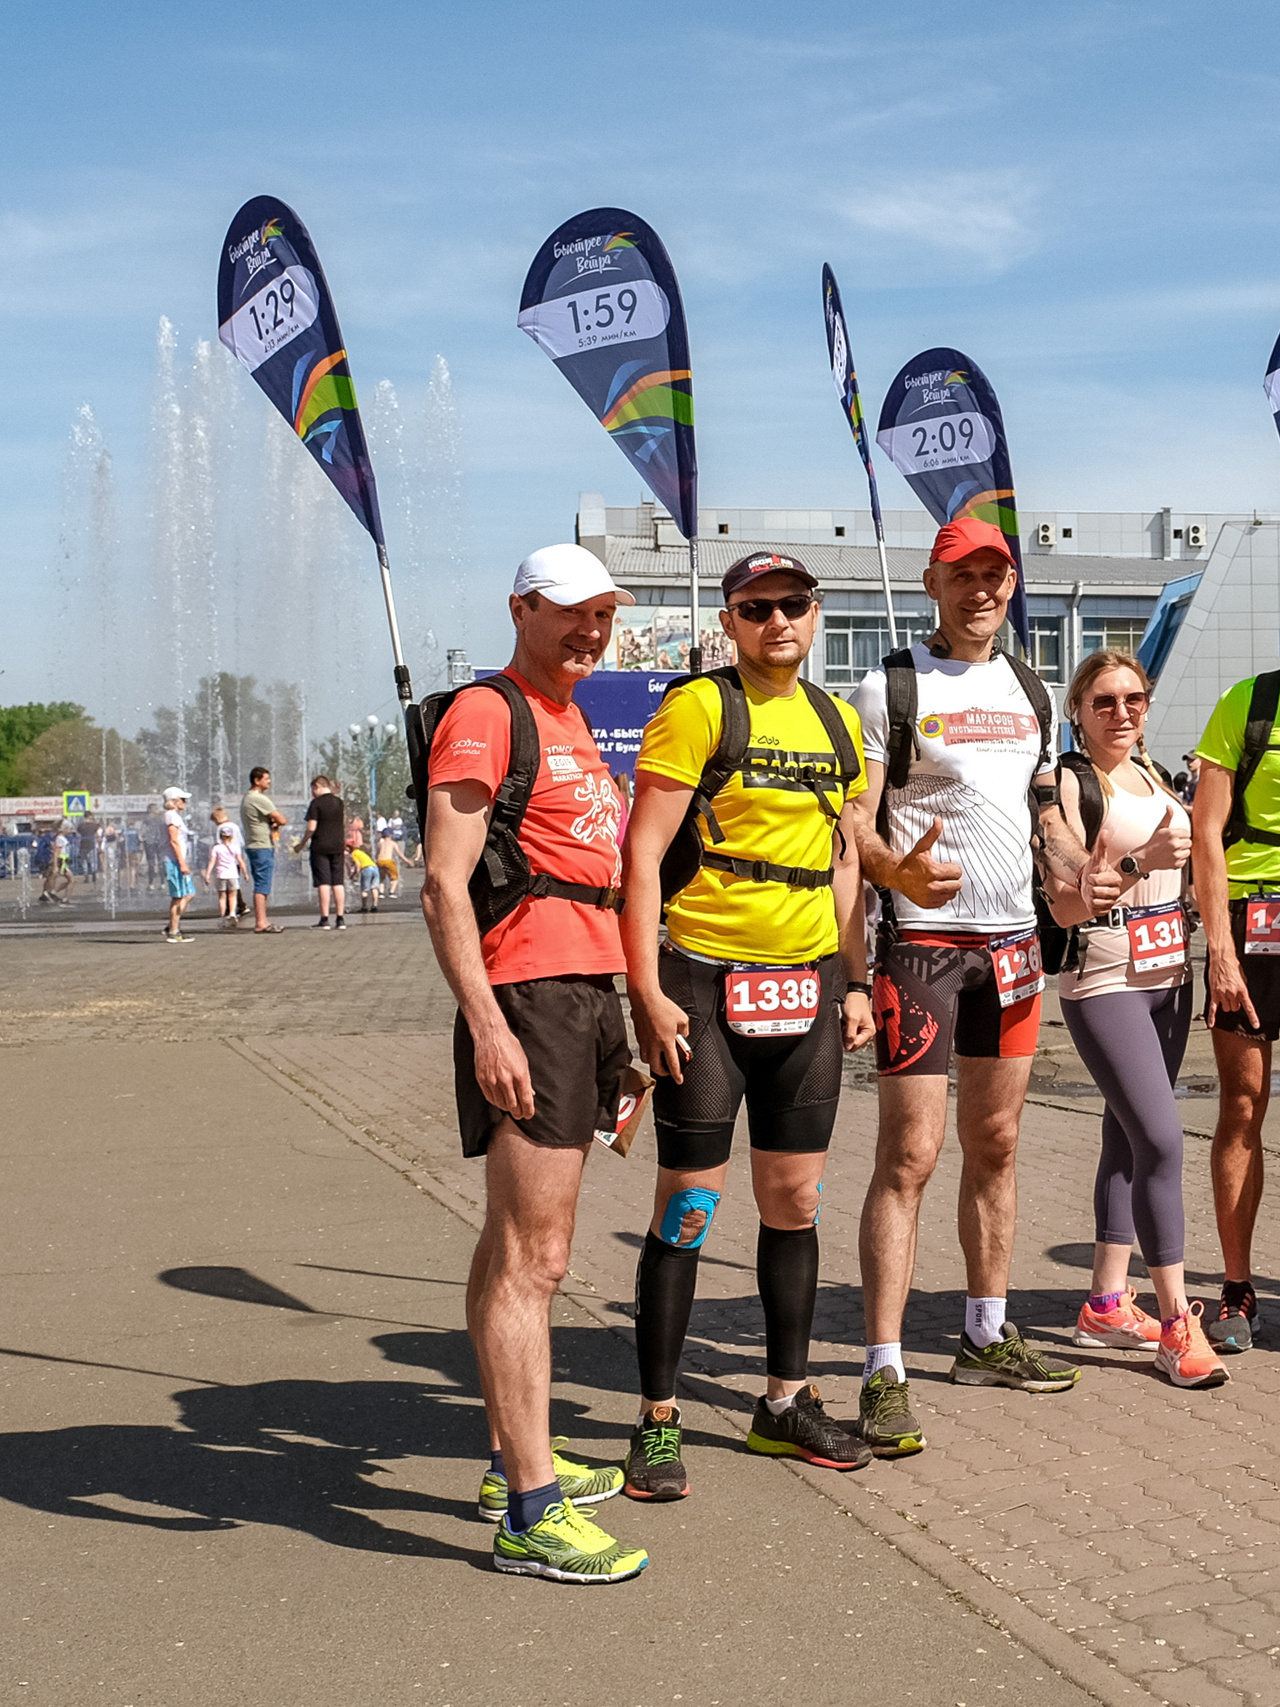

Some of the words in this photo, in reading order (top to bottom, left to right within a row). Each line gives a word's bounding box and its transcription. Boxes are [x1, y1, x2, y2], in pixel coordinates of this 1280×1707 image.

[228, 229, 260, 263] Быстрее
[553, 236, 602, 259] Быстрее
[245, 247, 271, 274] Ветра
[576, 254, 611, 274] Ветра
[249, 278, 295, 341] 1:29
[567, 288, 638, 334] 1:59
[578, 334, 598, 348] 5:39
[600, 329, 637, 342] мин/км
[904, 371, 943, 390] Быстрее
[922, 388, 951, 405] Ветра
[912, 417, 974, 457] 2:09
[923, 458, 940, 468] 6:06
[941, 454, 971, 465] мин/км
[966, 713, 1015, 727] МАРАФОН
[544, 745, 575, 756] TOMSK
[1134, 917, 1184, 953] 131
[998, 943, 1041, 985] 126
[732, 978, 818, 1012] 1338
